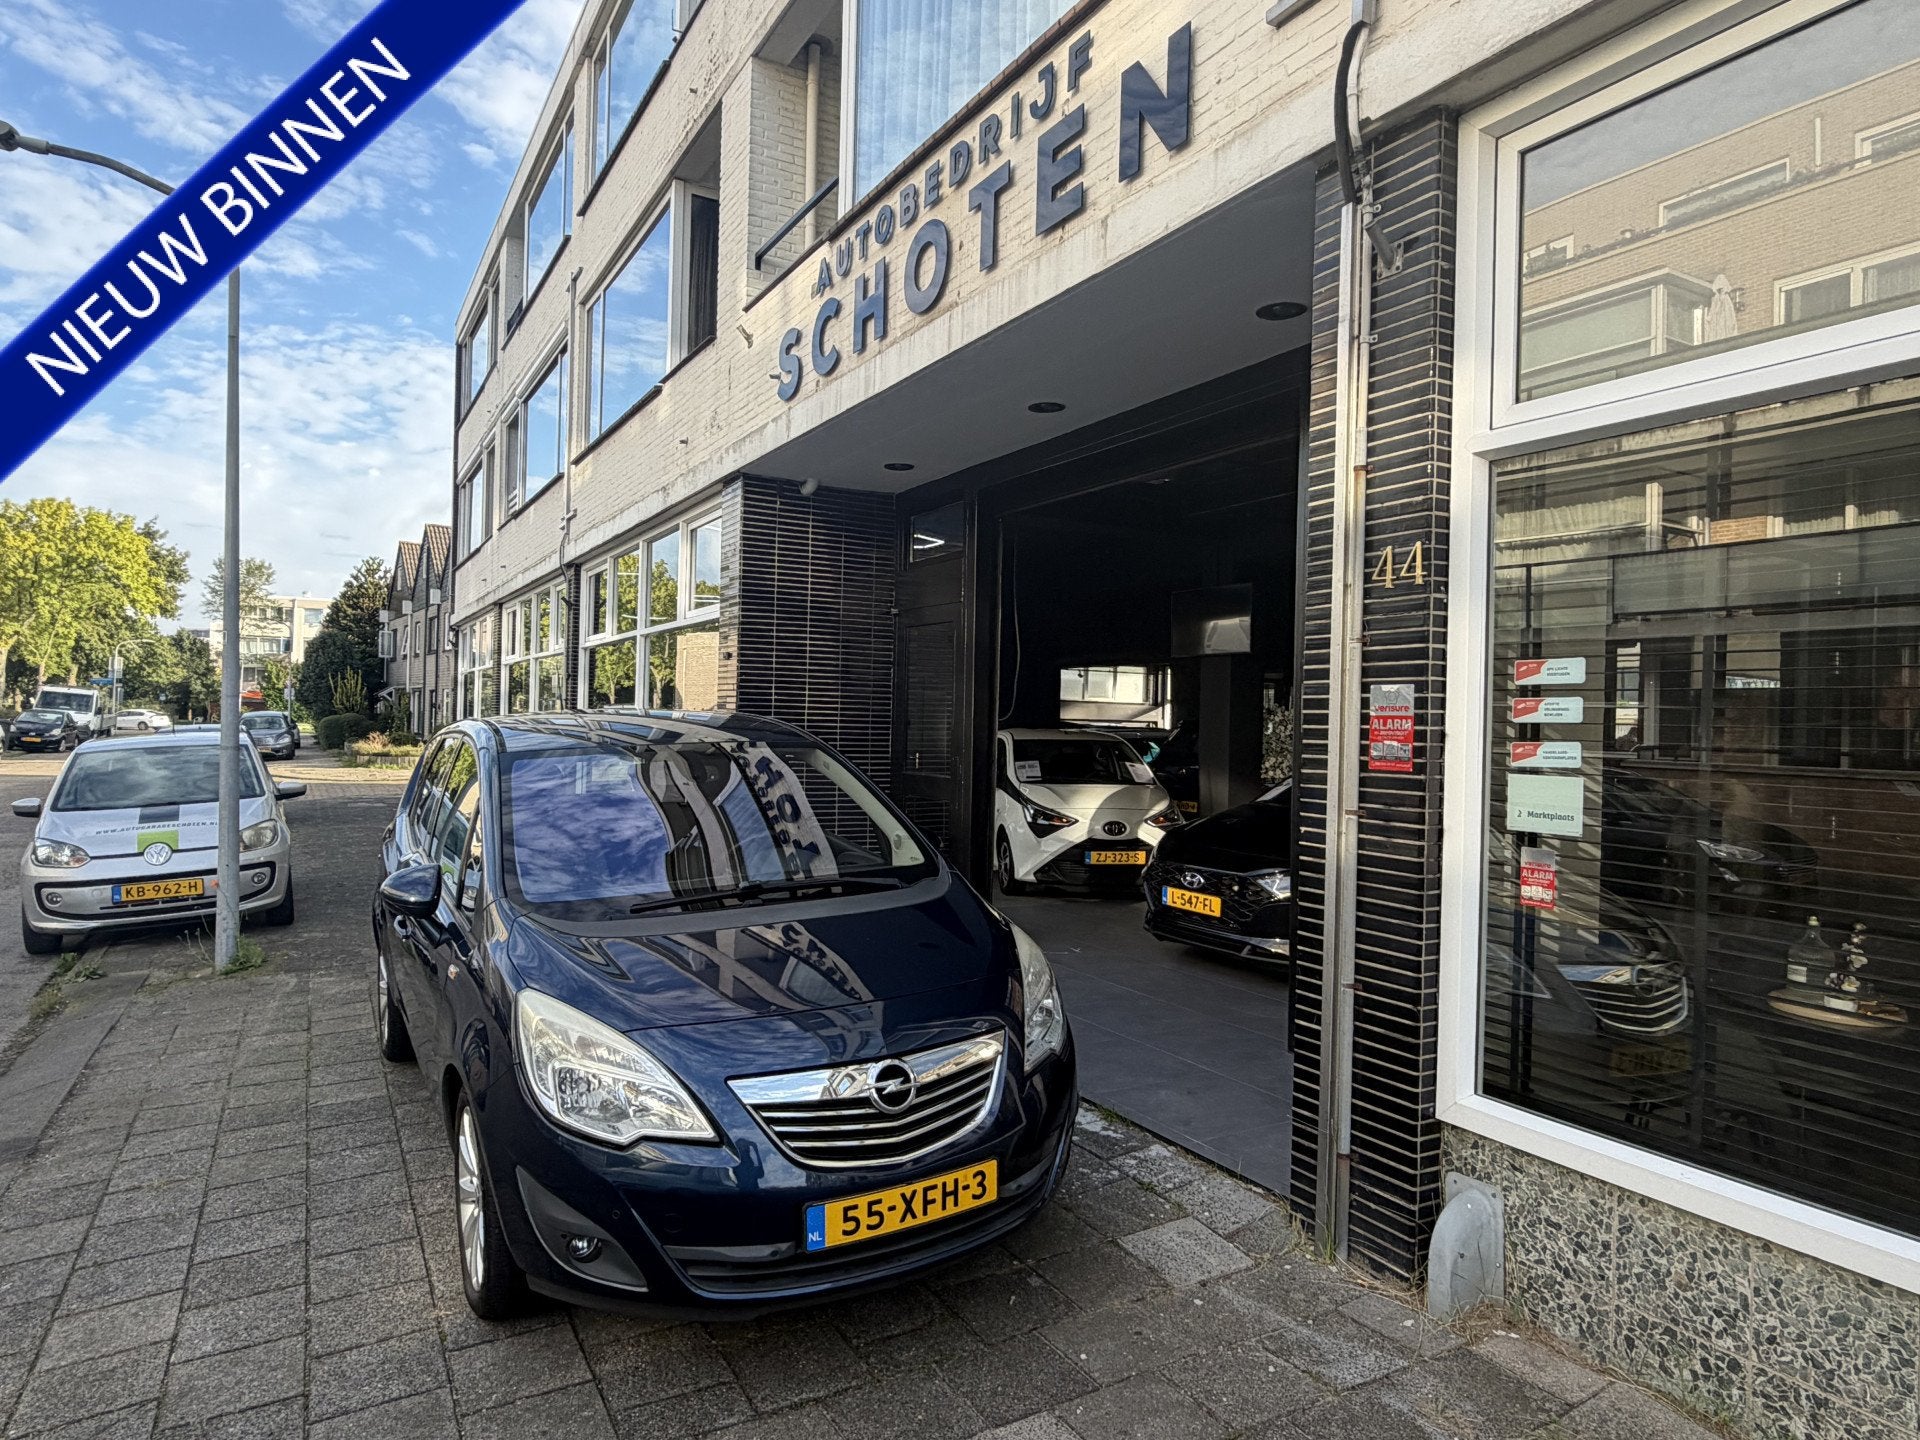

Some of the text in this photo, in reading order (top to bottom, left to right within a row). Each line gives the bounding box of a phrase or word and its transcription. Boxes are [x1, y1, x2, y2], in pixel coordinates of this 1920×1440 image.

[815, 29, 1094, 296] AUTOBEDRIJF
[776, 20, 1192, 402] SCHOTEN
[1371, 540, 1428, 589] 44
[1374, 704, 1411, 713] verisure
[1372, 718, 1413, 731] ALARM
[1527, 810, 1575, 822] Marktplaats
[1095, 852, 1140, 863] ZJ-323-S
[1521, 868, 1554, 881] ALARM
[124, 880, 199, 899] KB-962-H
[1171, 890, 1217, 914] L-547-FL
[808, 1169, 988, 1242] NL 55-XFH-3
